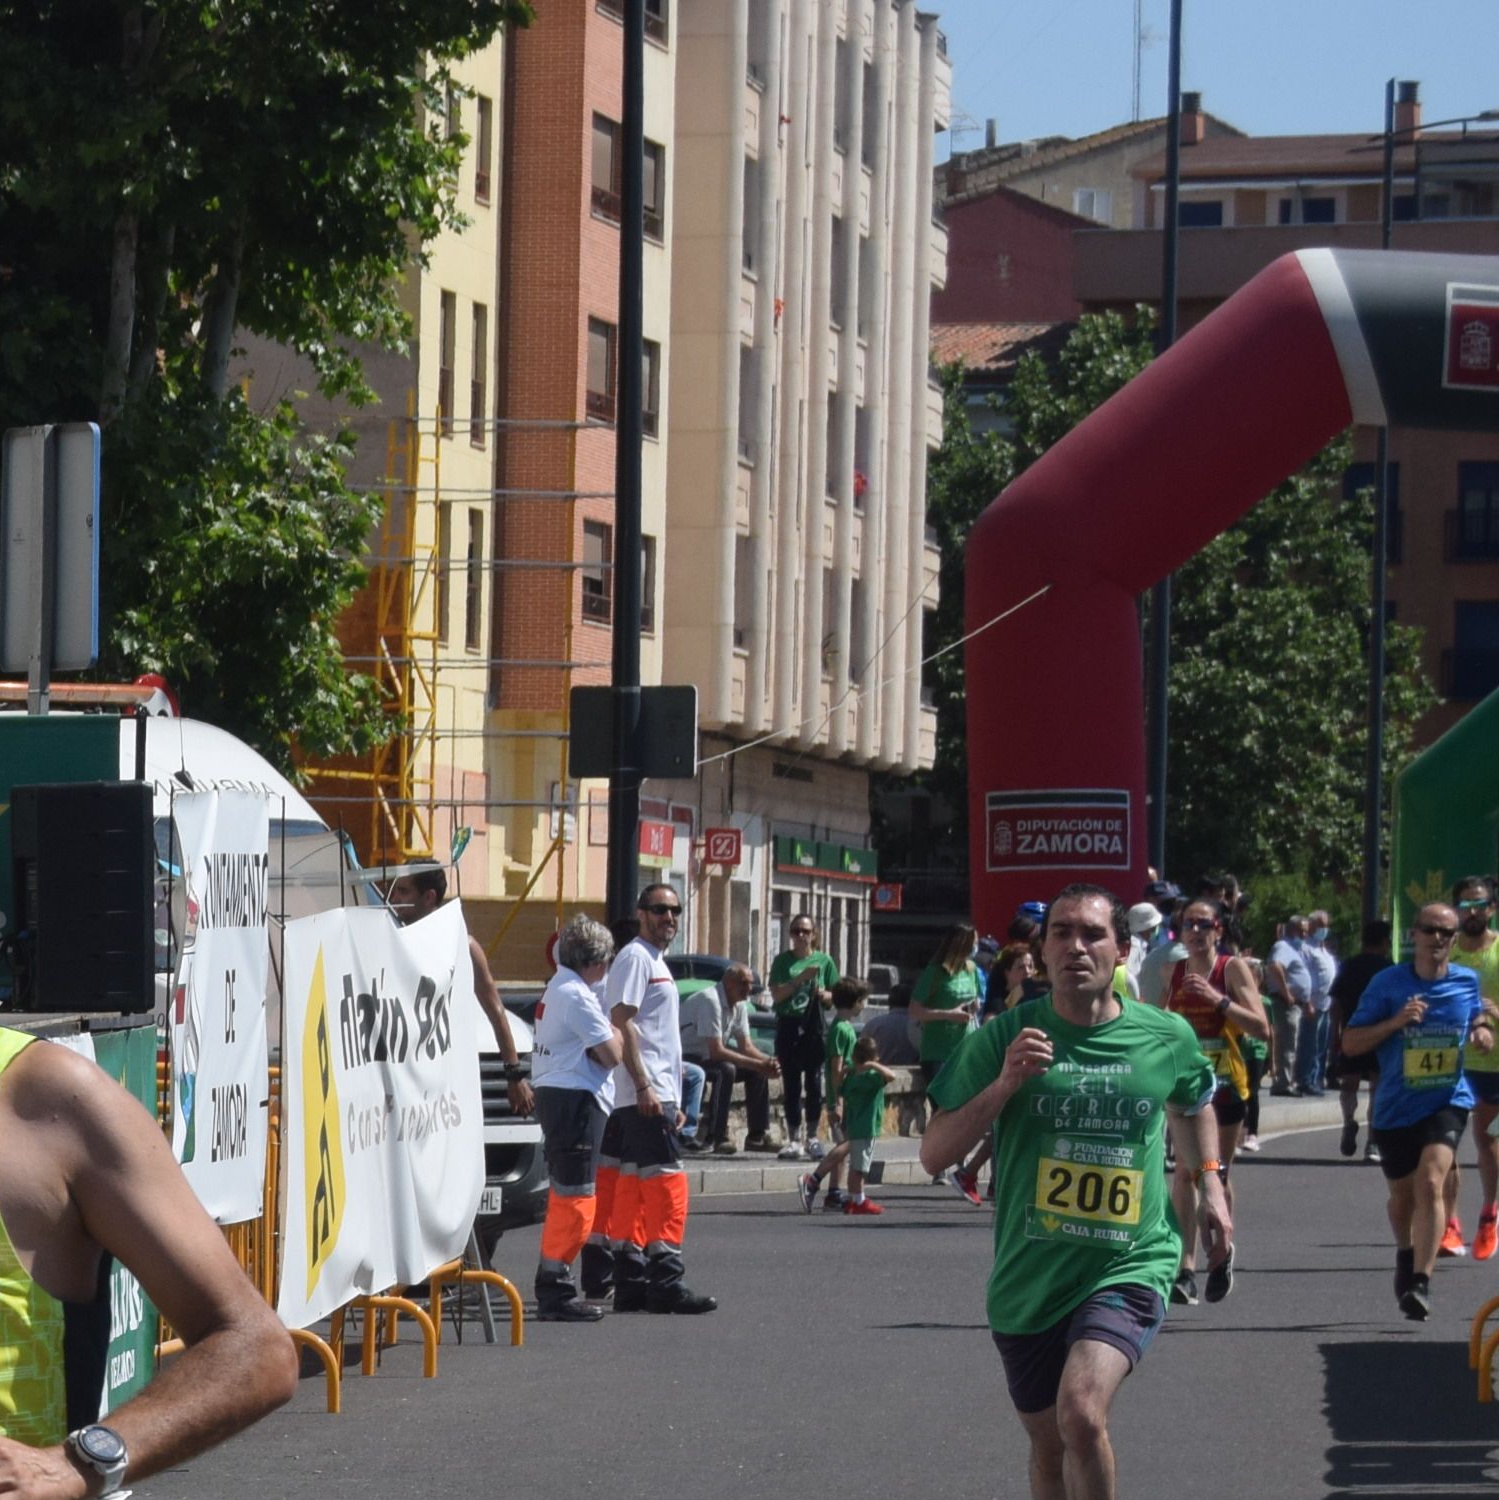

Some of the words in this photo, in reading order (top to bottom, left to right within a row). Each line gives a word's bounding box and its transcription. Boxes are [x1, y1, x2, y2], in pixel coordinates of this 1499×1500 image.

[1016, 818, 1102, 832] DIPUTACIÓN
[1105, 819, 1123, 832] DE
[1016, 834, 1123, 854] ZAMORA
[202, 853, 268, 929] YUNTAMIENTO
[224, 969, 236, 1044] DE
[1419, 1051, 1444, 1073] 41
[1036, 1097, 1151, 1117] CERCO
[211, 1083, 248, 1163] ZAMORA
[1077, 1117, 1131, 1130] ZAMORA
[1073, 1153, 1099, 1165] CAJA
[1100, 1155, 1133, 1168] RURAL
[1046, 1167, 1132, 1217] 206
[1062, 1223, 1090, 1237] CAJA
[1092, 1226, 1131, 1242] RURAL
